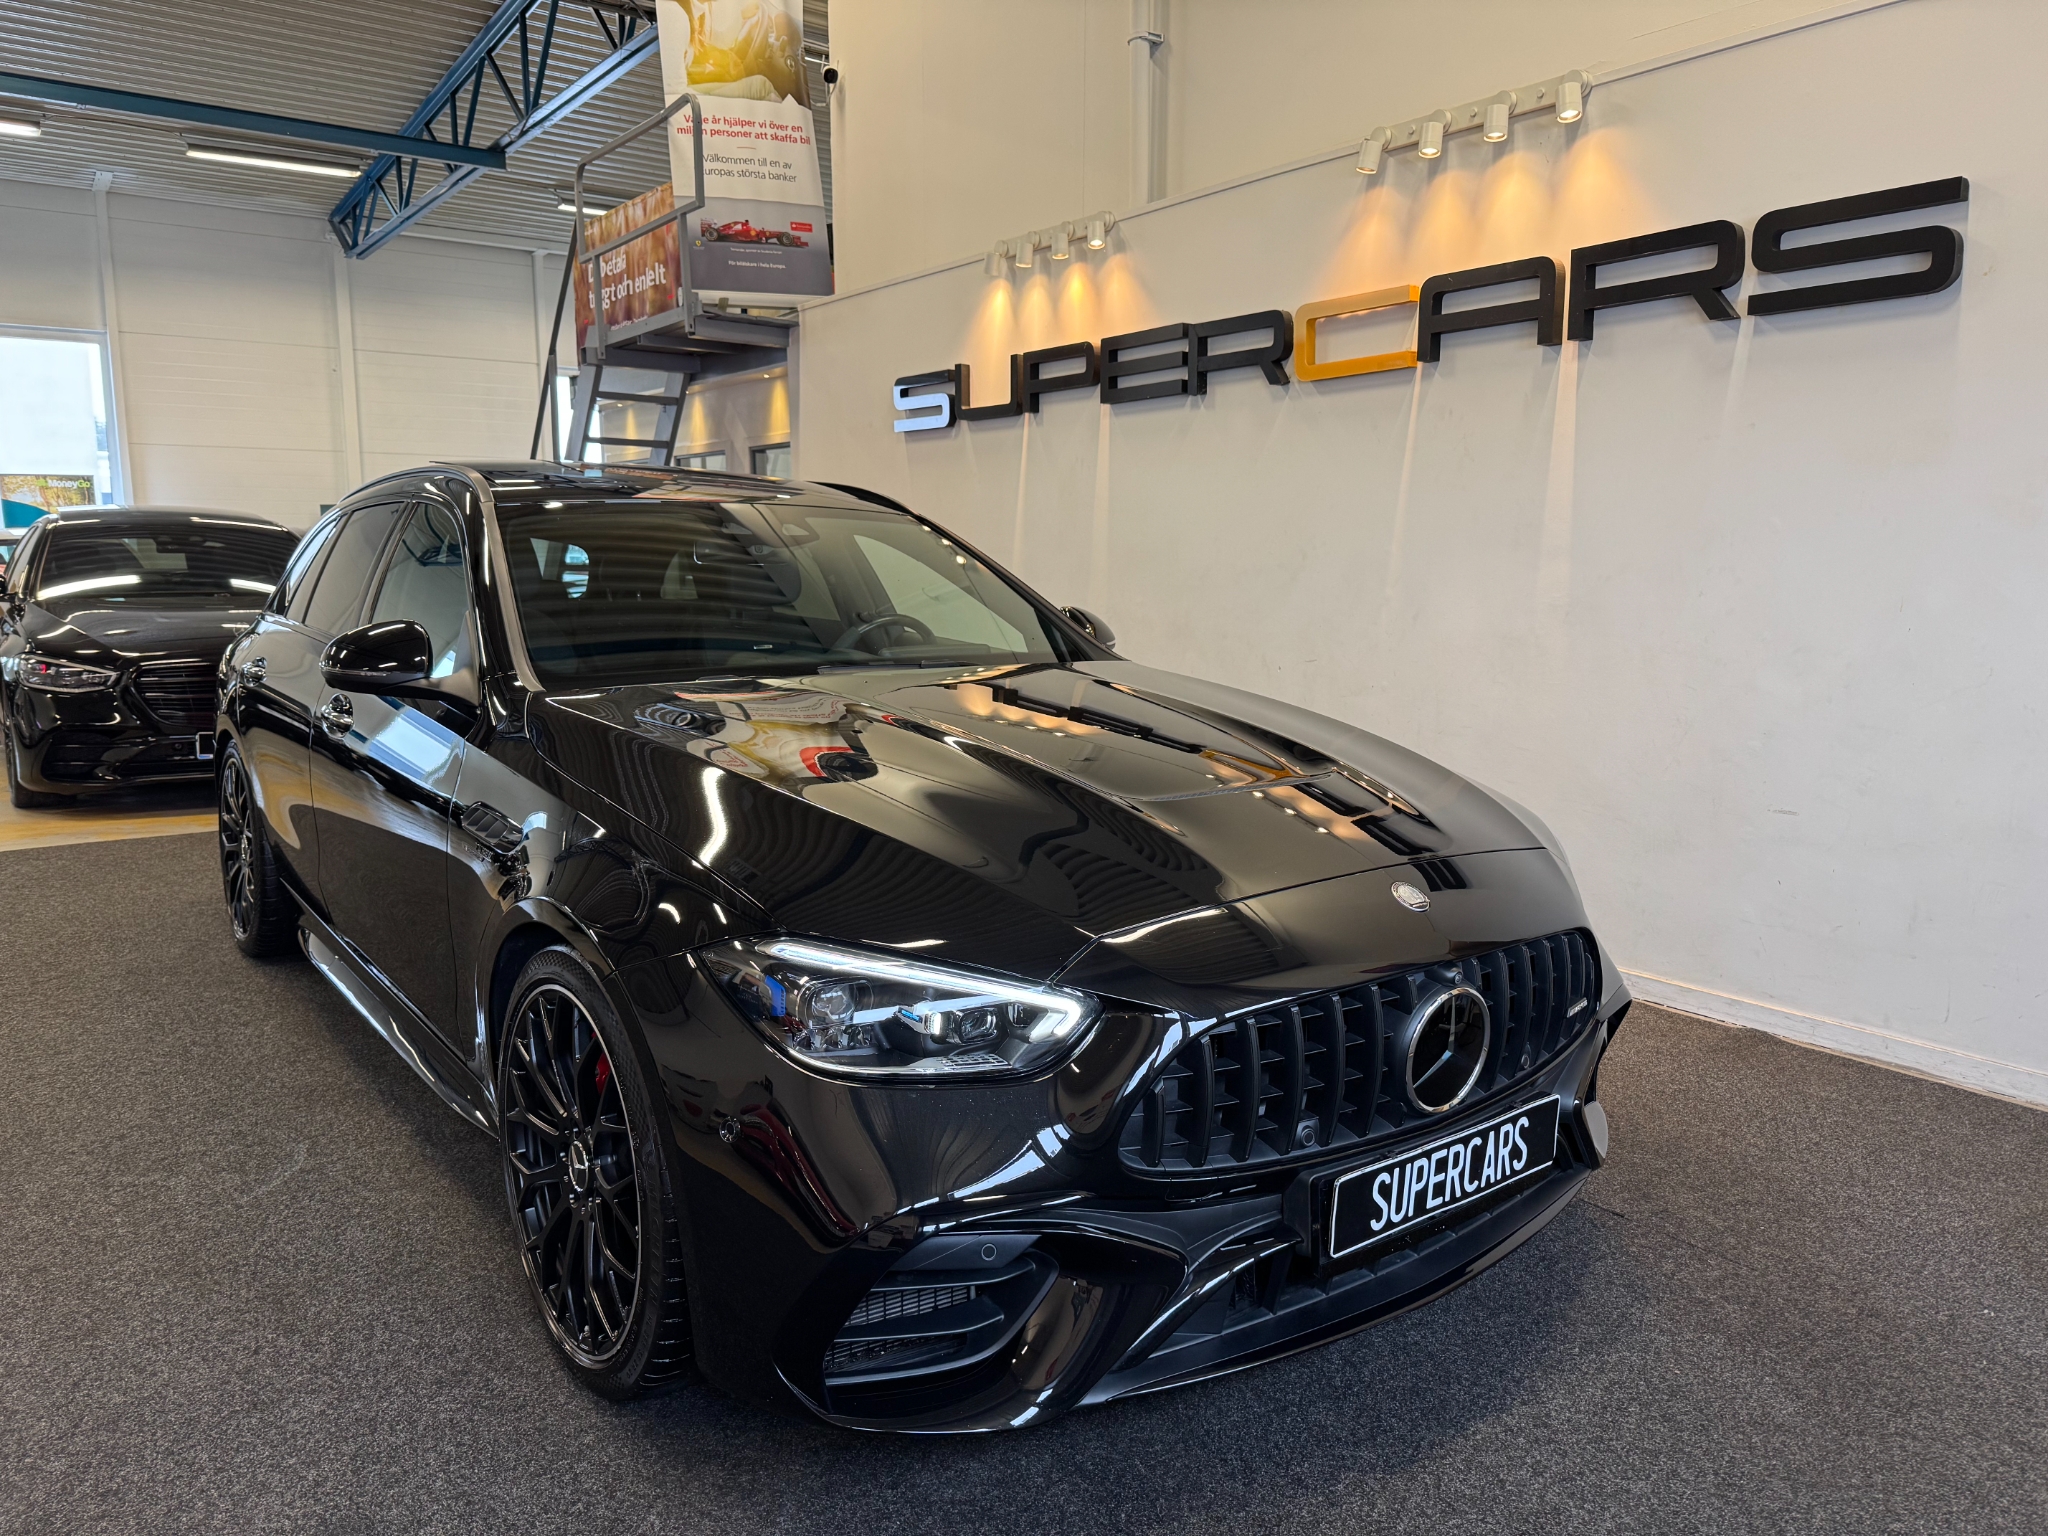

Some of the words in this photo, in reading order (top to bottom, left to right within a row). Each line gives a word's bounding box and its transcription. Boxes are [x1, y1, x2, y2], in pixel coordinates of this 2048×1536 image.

[711, 114, 722, 125] år
[723, 116, 756, 128] hjälper
[758, 120, 767, 129] vi
[769, 121, 789, 132] över
[791, 125, 803, 133] en
[710, 128, 752, 139] personer
[754, 132, 768, 140] att
[770, 133, 798, 144] skaffa
[800, 135, 811, 145] bil
[702, 153, 756, 166] Välkommen
[758, 157, 768, 167] till
[769, 160, 780, 168] en
[782, 161, 793, 170] av
[703, 167, 735, 178] uropas
[736, 169, 767, 180] största
[768, 170, 798, 183] banker
[892, 176, 1970, 434] SUPERCARS
[47, 479, 91, 489] MoneyGo
[1370, 1116, 1530, 1231] SUPERCARS
